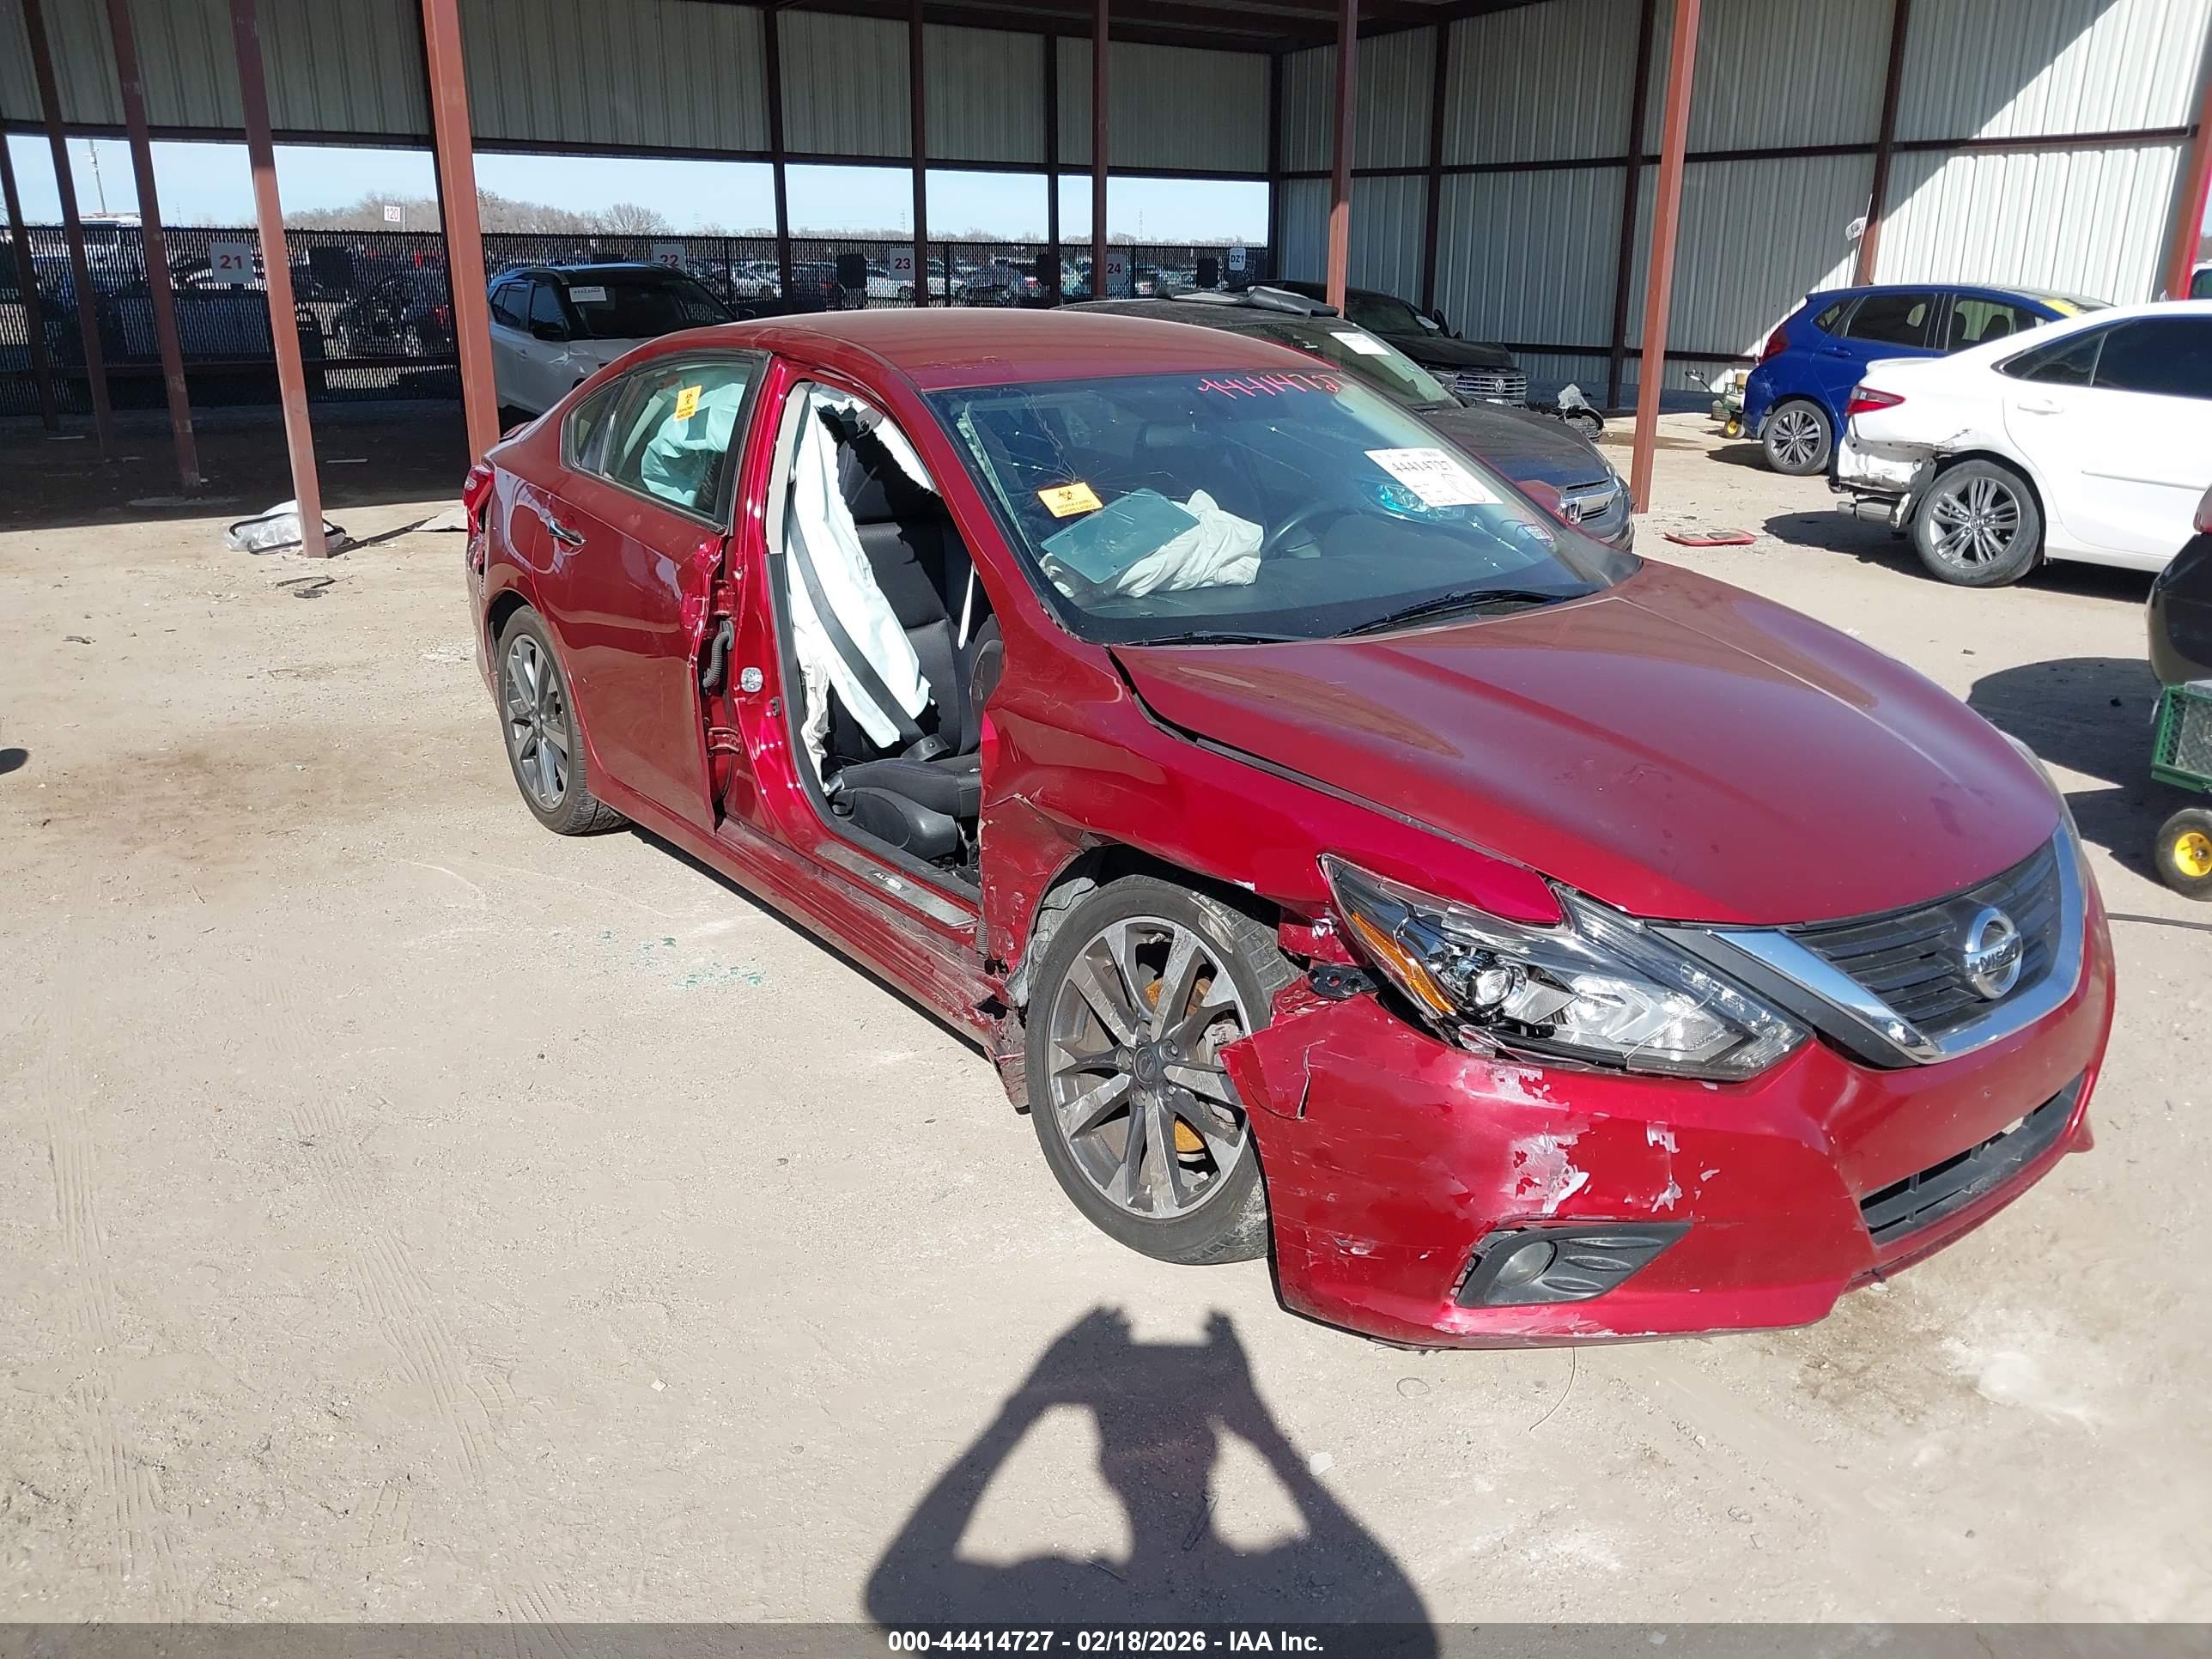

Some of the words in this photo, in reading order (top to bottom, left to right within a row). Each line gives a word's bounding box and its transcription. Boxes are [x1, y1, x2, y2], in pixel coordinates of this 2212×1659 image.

[386, 207, 399, 221] 120
[219, 254, 242, 270] 21
[659, 254, 679, 266] 22
[895, 258, 911, 270] 23
[1231, 254, 1244, 264] DZ1
[1108, 263, 1121, 274] 24
[1392, 460, 1453, 472] 44414727
